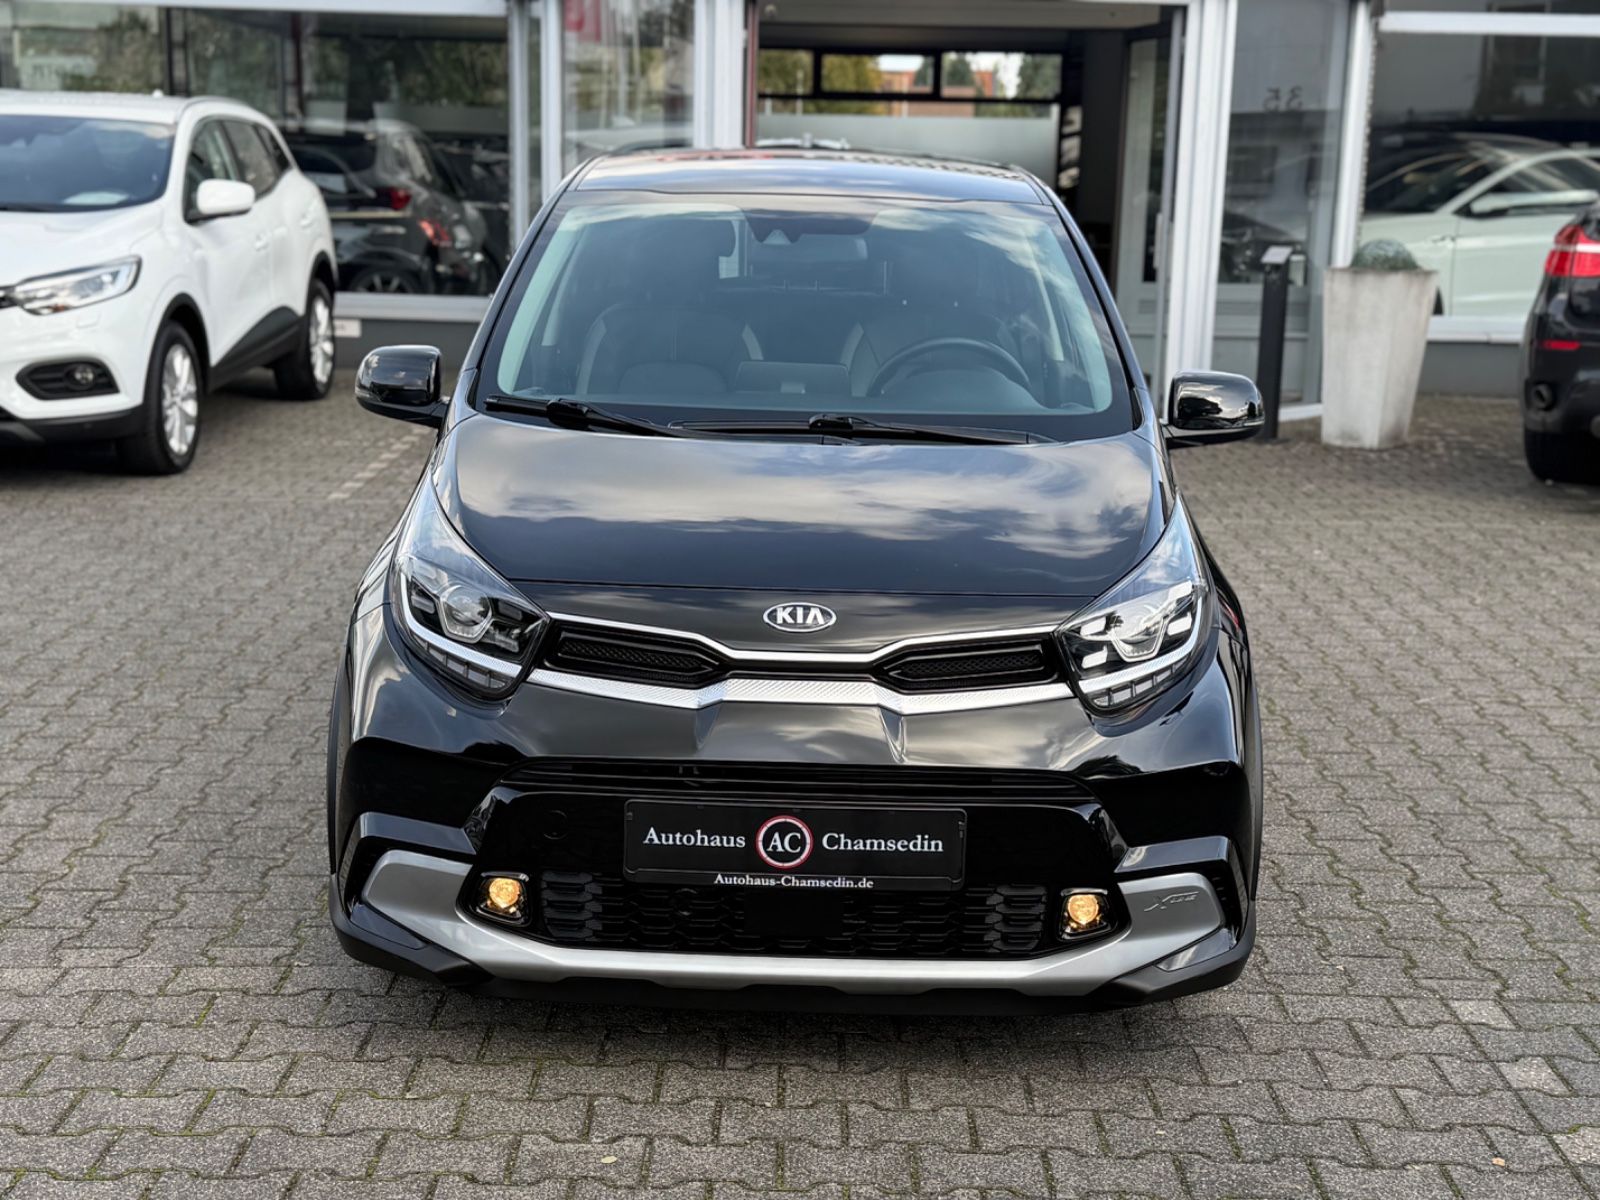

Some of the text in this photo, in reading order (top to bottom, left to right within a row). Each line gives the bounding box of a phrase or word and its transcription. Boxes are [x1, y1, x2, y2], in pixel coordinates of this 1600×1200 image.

[775, 606, 826, 625] KIA
[643, 826, 944, 853] Autohaus AC Chamsedin
[714, 873, 874, 889] Autohaus-Chamsedin.de
